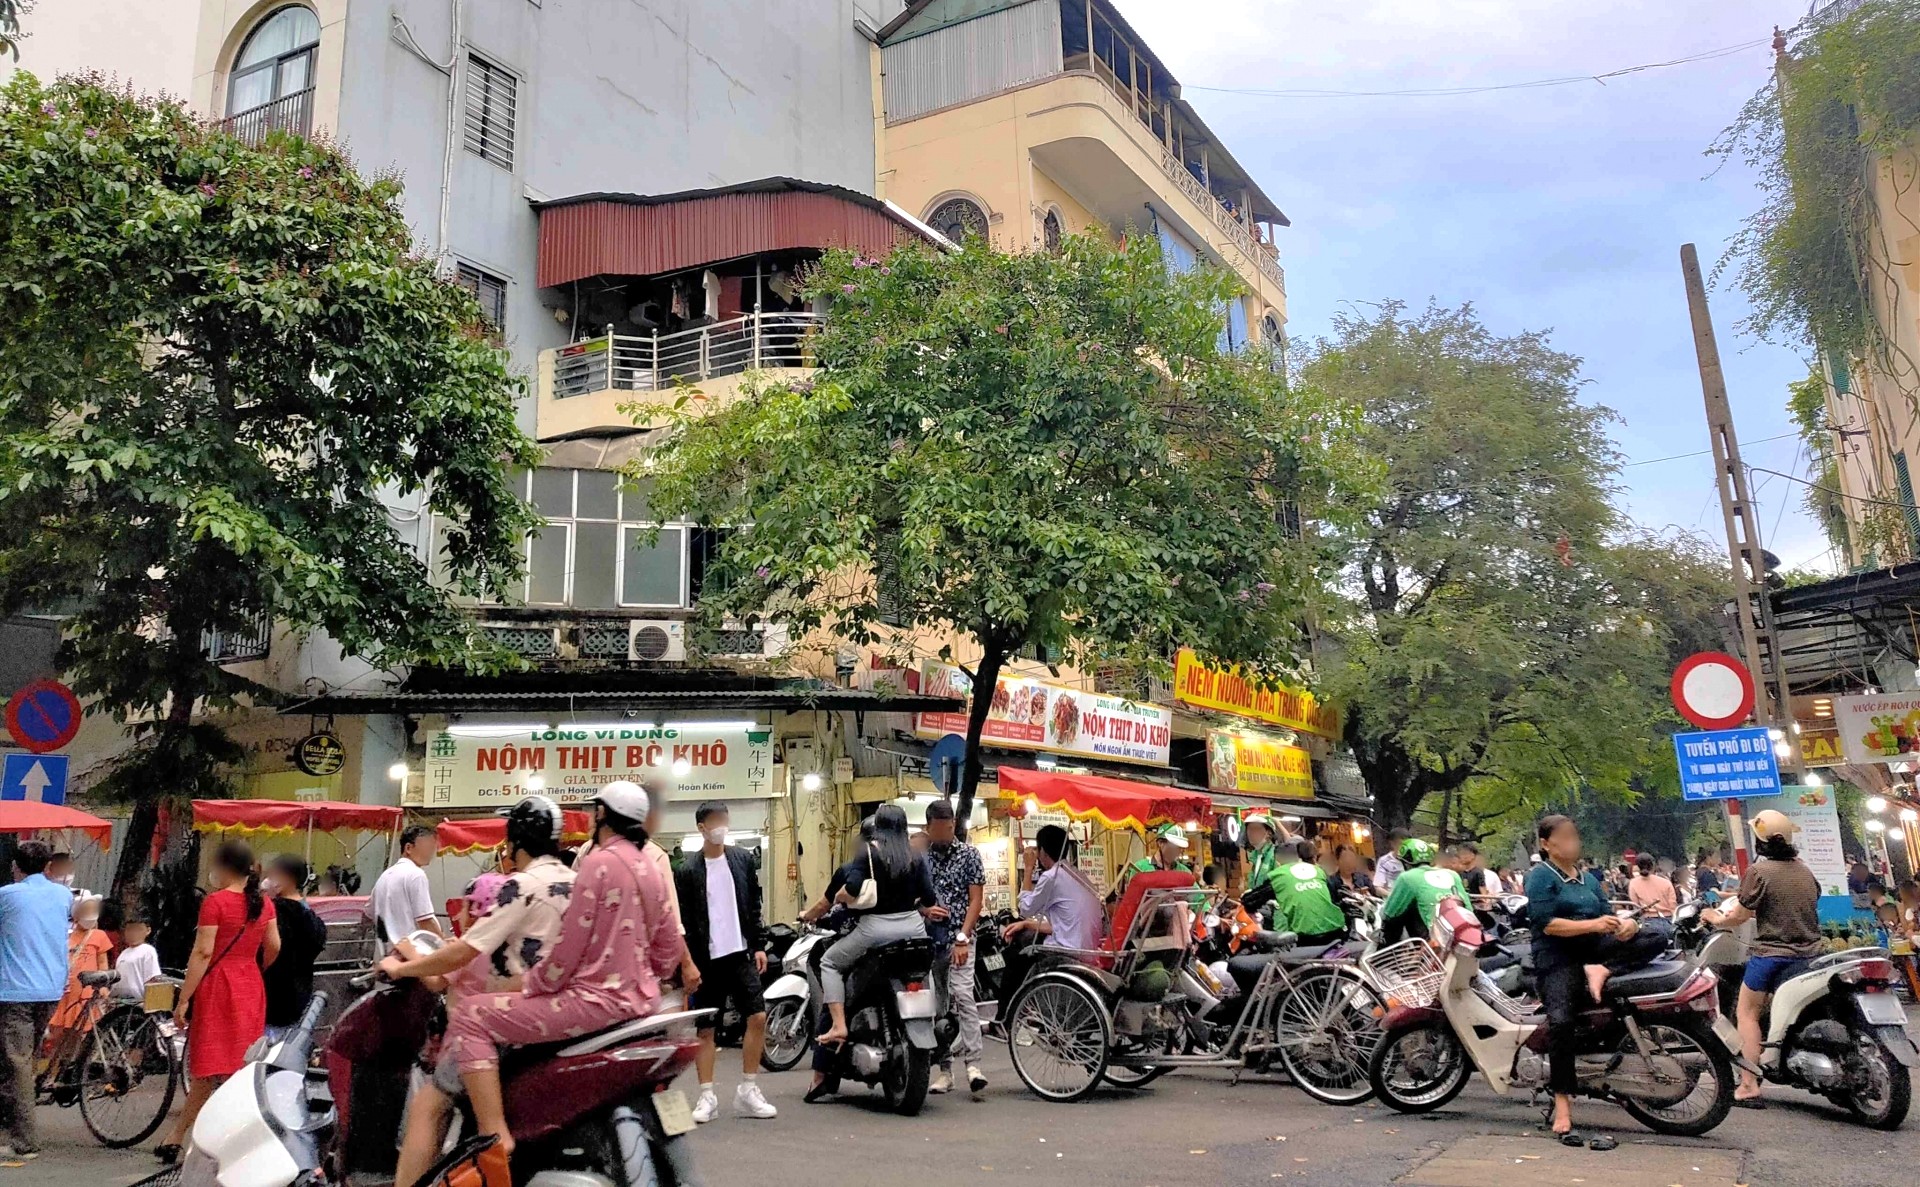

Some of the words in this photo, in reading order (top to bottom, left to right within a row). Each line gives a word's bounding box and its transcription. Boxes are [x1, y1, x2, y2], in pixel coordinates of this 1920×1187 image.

[1186, 665, 1214, 699] NEM
[1278, 690, 1304, 722] TRANG
[531, 730, 588, 741] LONG
[620, 729, 678, 739] DUNG
[1082, 708, 1106, 740] NỘM
[1109, 717, 1132, 745] THỊT
[1134, 717, 1147, 744] BÒ
[1149, 721, 1169, 747] KHÔ
[1107, 744, 1121, 755] NGON
[1684, 737, 1717, 757] TUYẾN
[1718, 735, 1739, 755] PHỐ
[1740, 739, 1752, 753] ĐI
[1753, 734, 1767, 755] BỘ
[477, 743, 545, 774] NỘM
[556, 746, 617, 772] THỊT
[626, 741, 663, 767] BÒ
[673, 739, 727, 767] KHÔ
[1238, 748, 1253, 766] NEM
[563, 775, 587, 784] GIA
[747, 749, 768, 793] 牛肉干
[432, 766, 452, 803] 中国
[546, 787, 565, 795] Tiên
[568, 786, 598, 796] Hoàng
[1294, 879, 1323, 892] Grab
